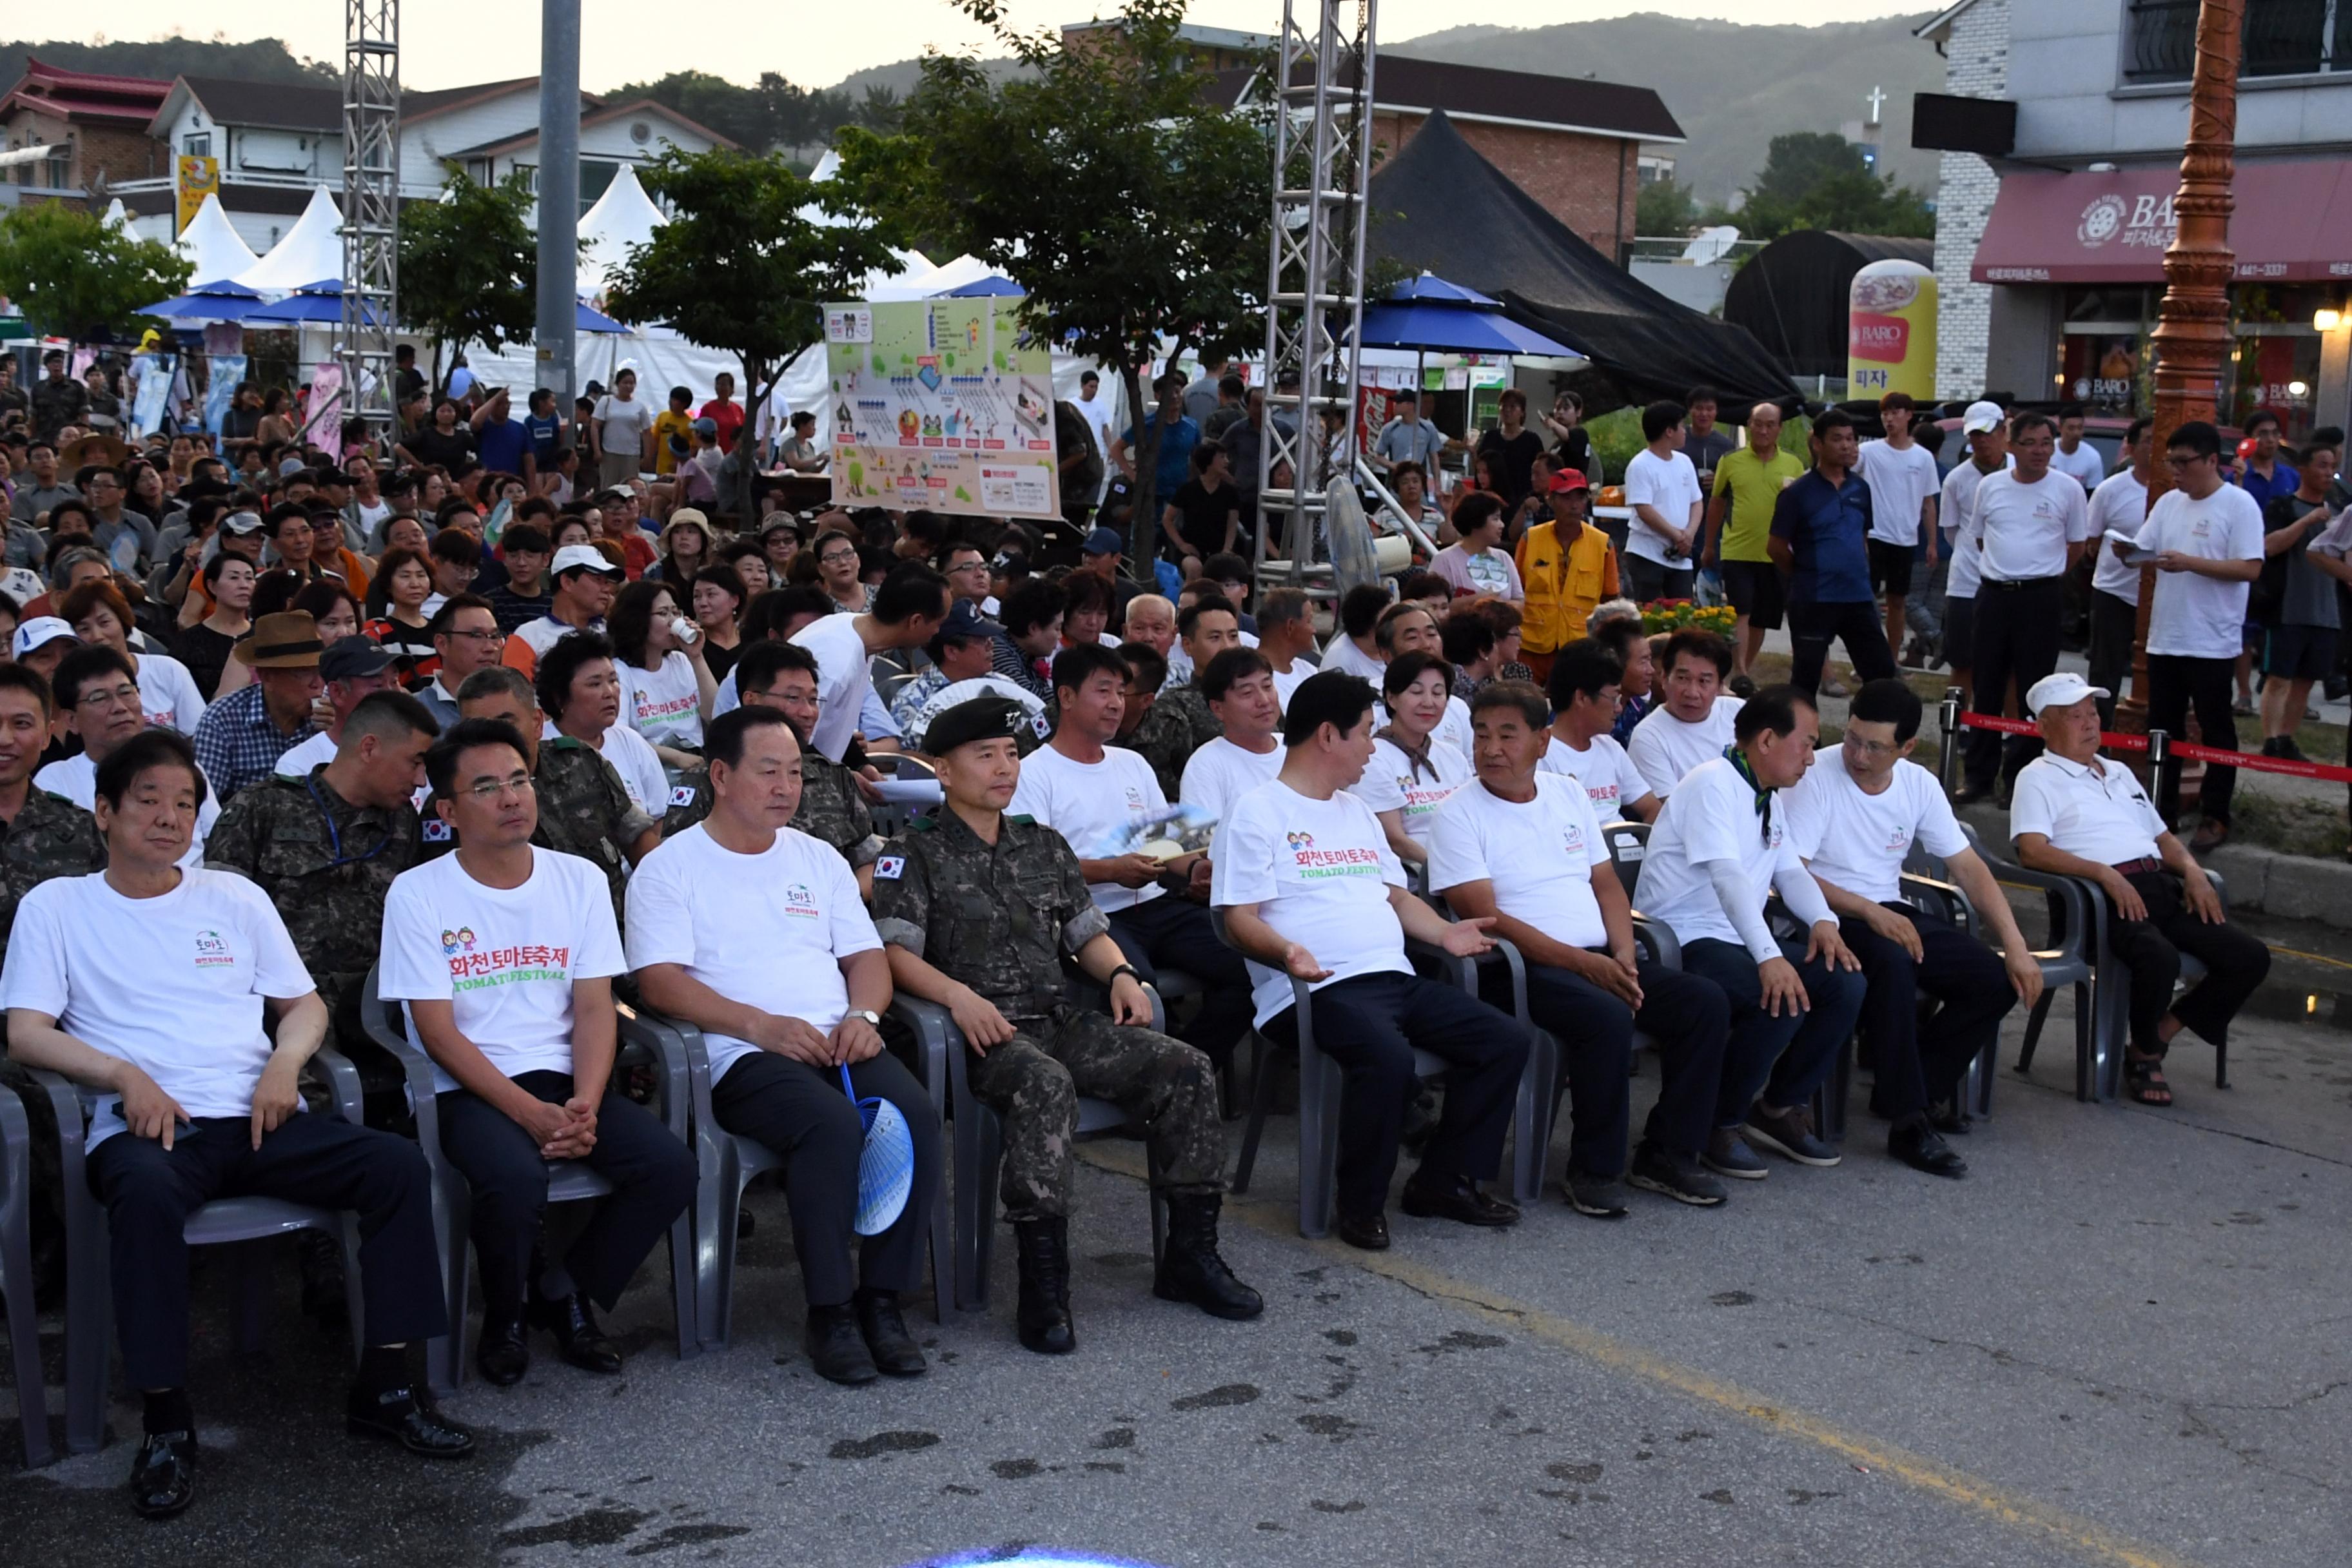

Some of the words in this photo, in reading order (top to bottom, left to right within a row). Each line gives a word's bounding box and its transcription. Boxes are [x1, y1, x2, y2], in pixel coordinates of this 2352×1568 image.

[2127, 195, 2179, 227] BA
[1862, 326, 1901, 341] BARO
[1855, 369, 1888, 388] 피자
[2093, 379, 2130, 394] BARO
[1300, 867, 1345, 878] TOMATO
[449, 945, 569, 977] 화천토마토축제
